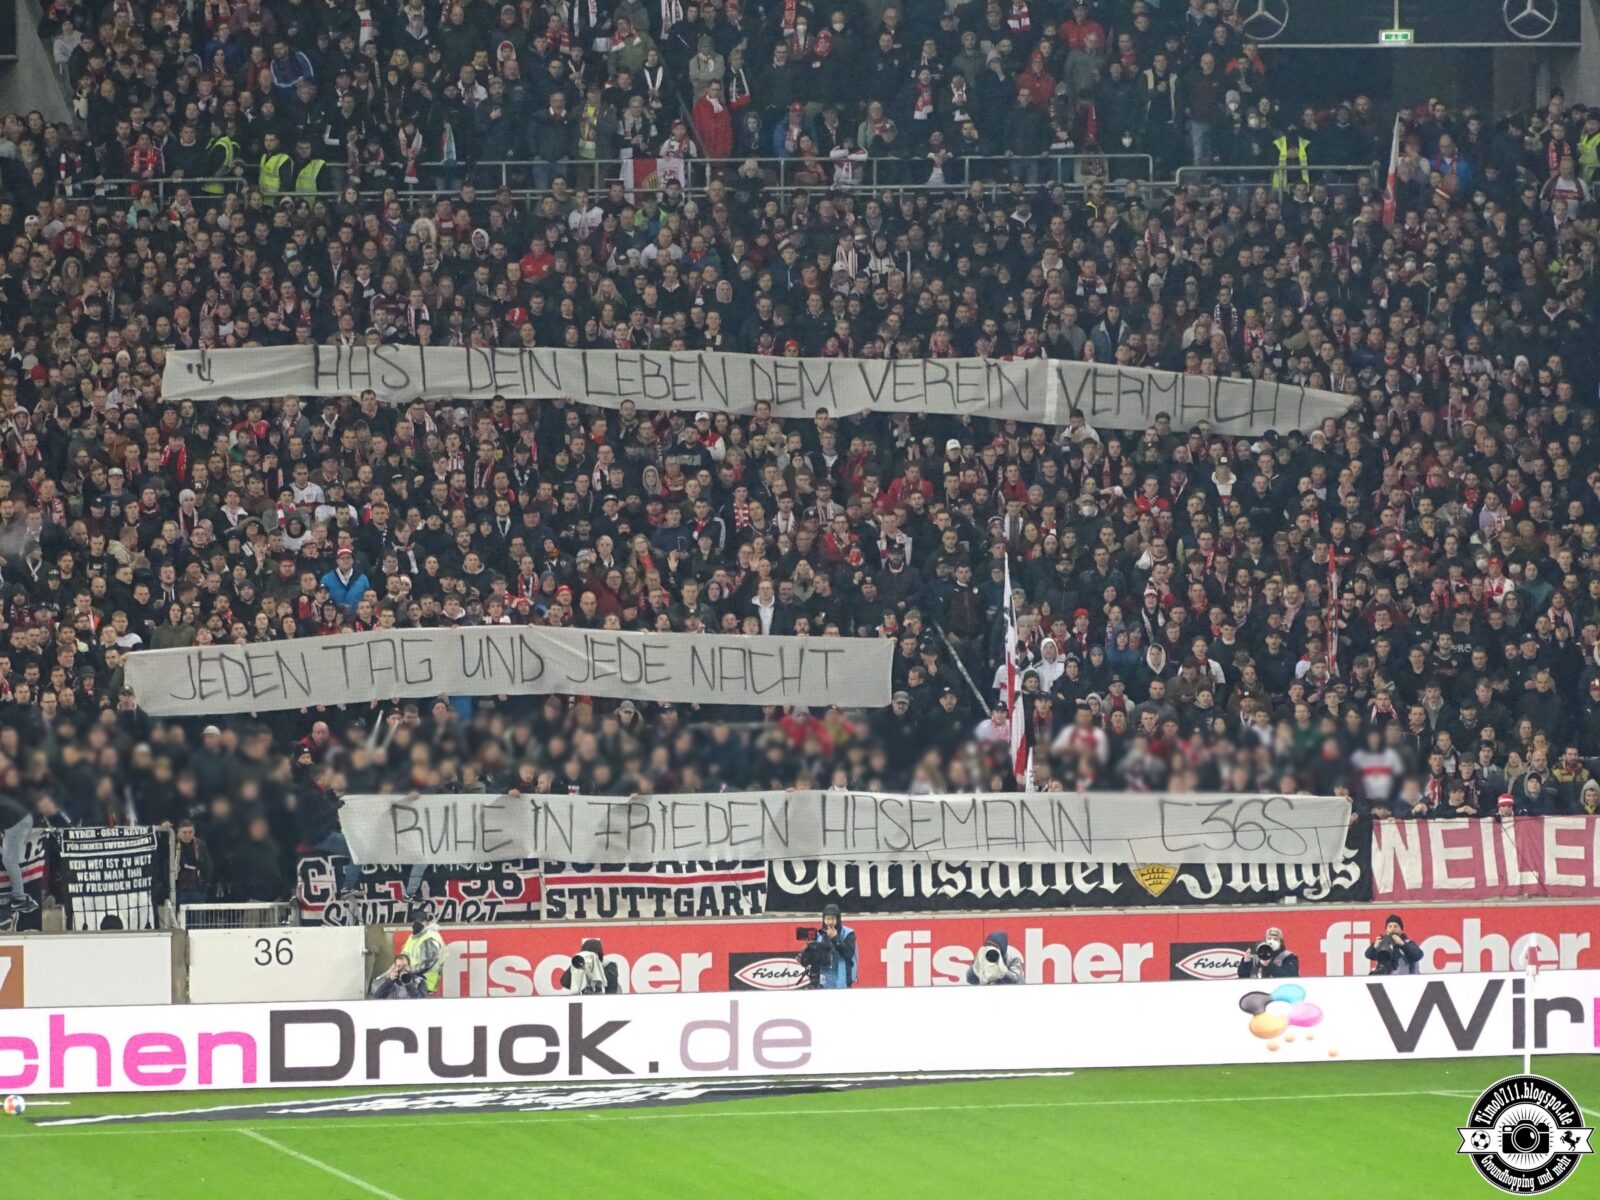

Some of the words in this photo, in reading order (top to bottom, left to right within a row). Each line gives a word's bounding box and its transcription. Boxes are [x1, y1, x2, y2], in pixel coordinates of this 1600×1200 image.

[466, 346, 561, 395] DEIN
[582, 351, 729, 407] LEBEN
[750, 358, 838, 410] DEM
[858, 357, 1029, 411] VEREIN
[169, 648, 311, 700] JEDEN
[321, 637, 434, 687] TAG
[460, 633, 545, 685] UND
[566, 633, 672, 684] JEDE
[690, 645, 846, 696] NACHT
[68, 829, 96, 840] RYDER
[390, 802, 514, 856] RUHE
[529, 798, 574, 854] IN
[586, 797, 790, 854] FRIEDEN
[821, 795, 1093, 855] HASEMANN
[69, 859, 86, 870] KEIN
[106, 857, 119, 869] IST
[122, 856, 132, 867] ZU
[1372, 815, 1600, 895] WEILE
[68, 883, 83, 893] MIT
[76, 870, 101, 881] WENN
[104, 869, 124, 880] MAN
[545, 882, 767, 919] STUTTGART
[253, 937, 294, 966] 36
[1366, 977, 1600, 1053] Wir
